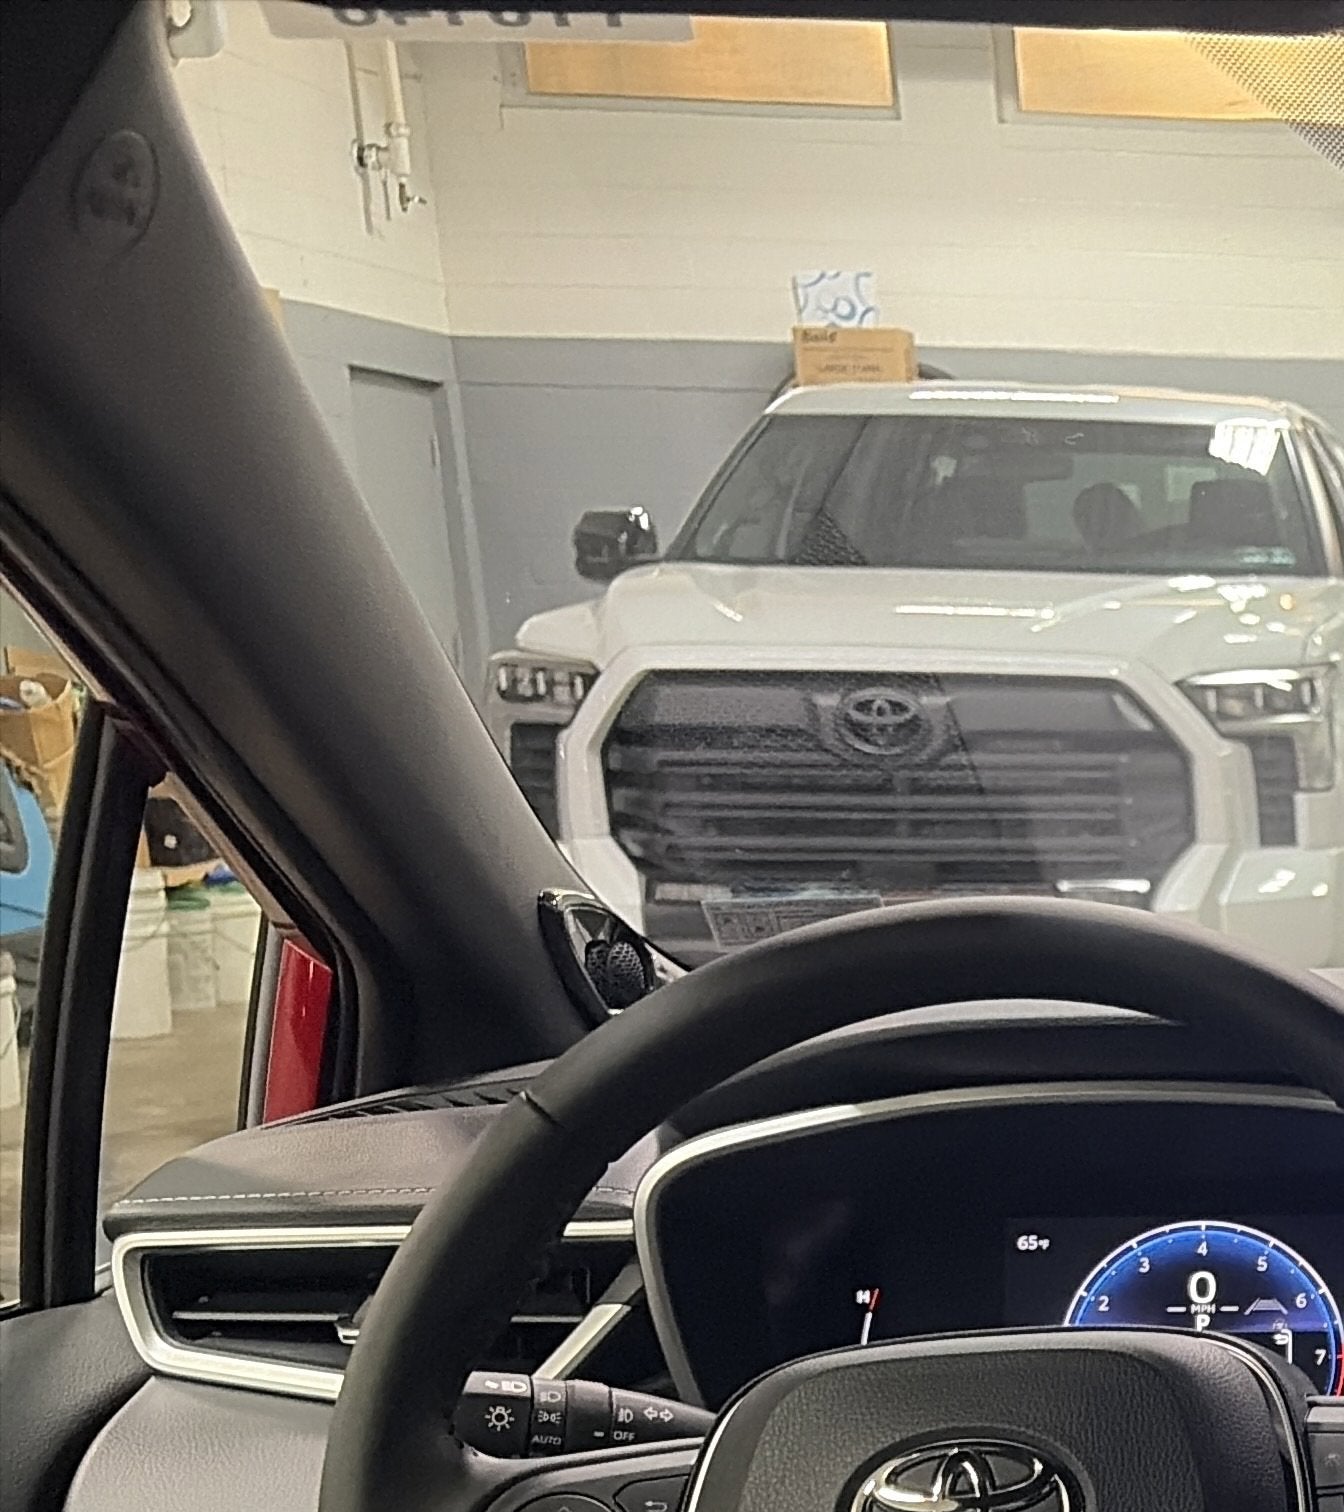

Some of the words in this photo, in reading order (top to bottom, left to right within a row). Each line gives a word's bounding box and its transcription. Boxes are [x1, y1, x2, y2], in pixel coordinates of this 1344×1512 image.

[1196, 1240, 1208, 1257] 4
[1138, 1257, 1151, 1273] 3
[1256, 1256, 1268, 1272] 5
[1188, 1270, 1217, 1304] 0
[856, 1289, 871, 1304] H
[1098, 1295, 1110, 1312] 2
[1295, 1294, 1307, 1309] 6
[1190, 1303, 1216, 1315] MPH
[1195, 1313, 1211, 1332] P
[1314, 1349, 1327, 1366] 7
[531, 1435, 562, 1445] AUTO
[613, 1431, 636, 1441] OFF
